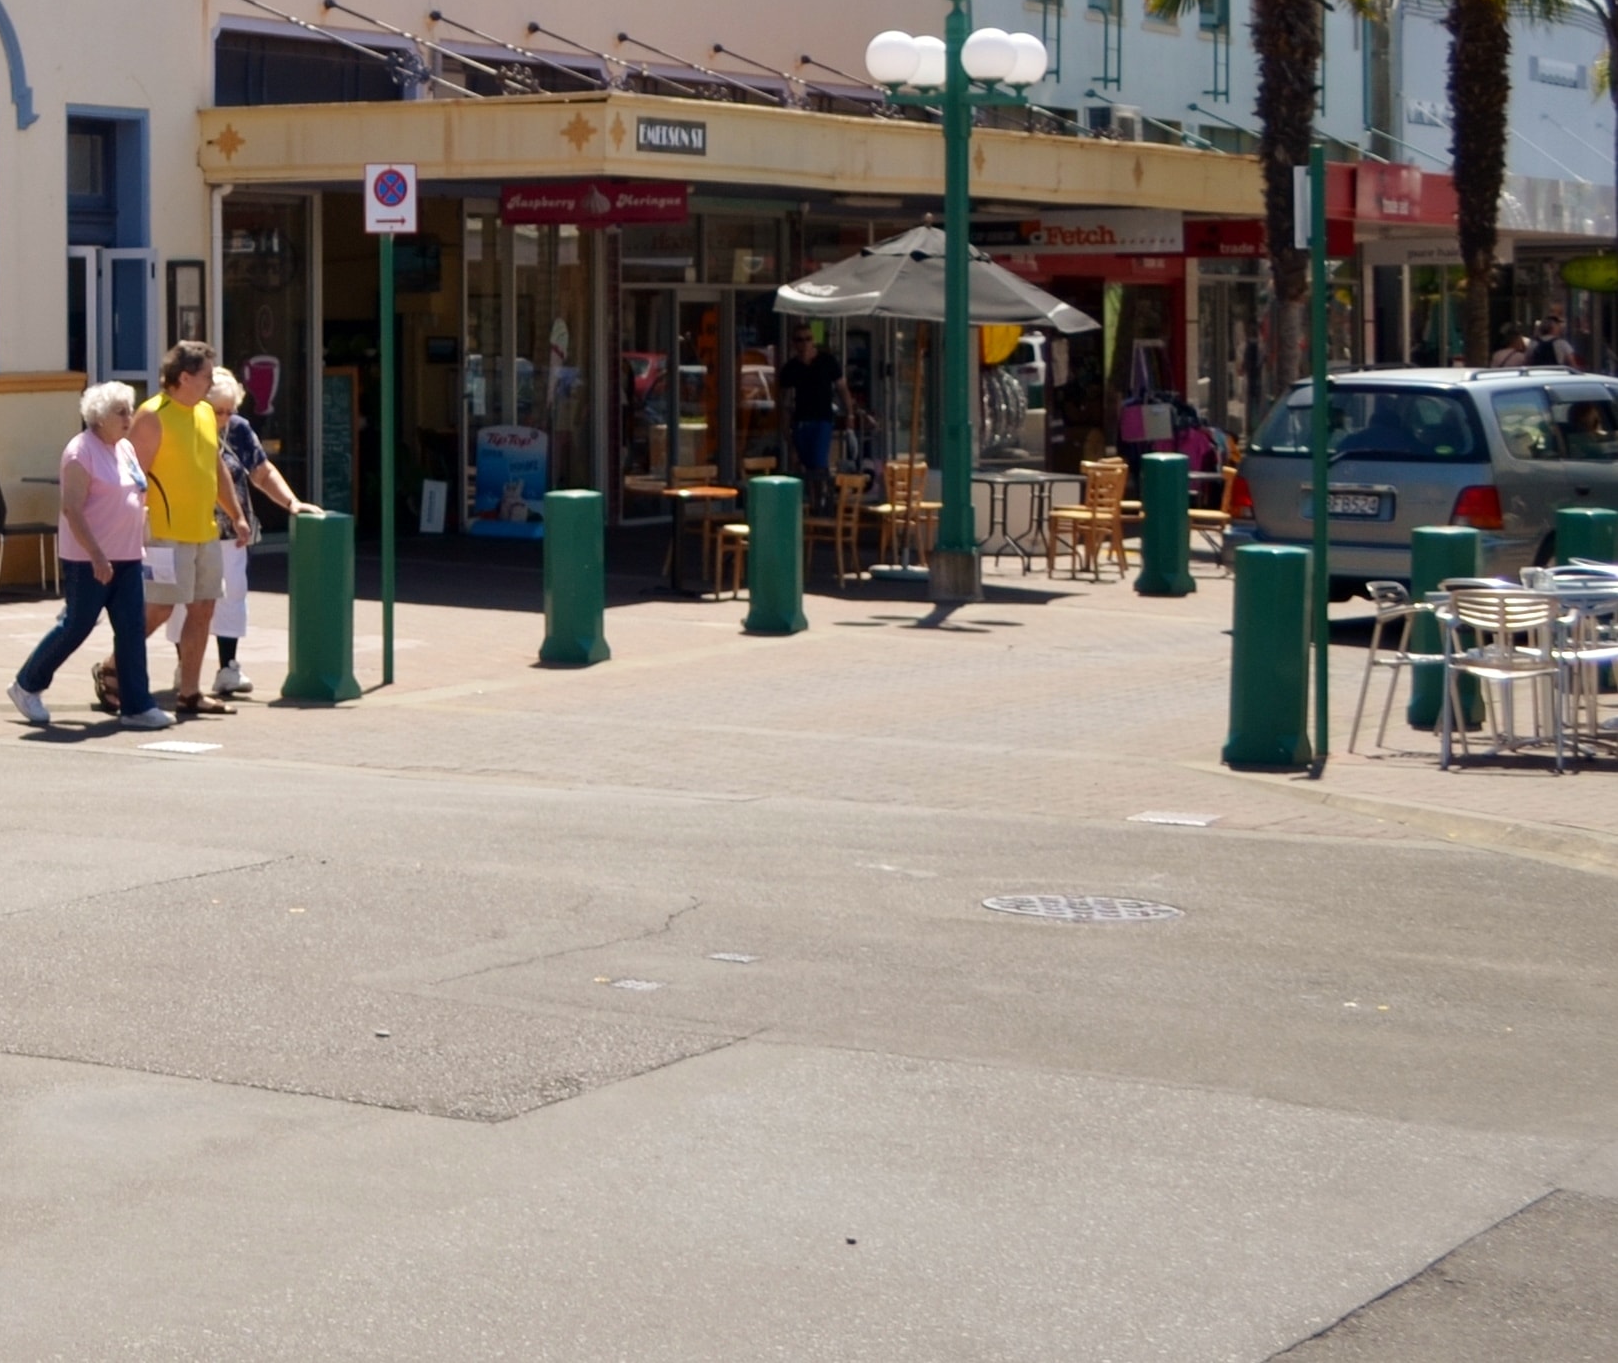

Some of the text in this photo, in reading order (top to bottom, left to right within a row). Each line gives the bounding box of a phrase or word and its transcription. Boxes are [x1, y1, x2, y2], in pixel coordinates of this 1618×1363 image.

[639, 123, 704, 149] EMERSON ST
[507, 193, 681, 211] Raspberry Meringue
[1043, 224, 1116, 246] Fetch
[1219, 242, 1254, 254] trade
